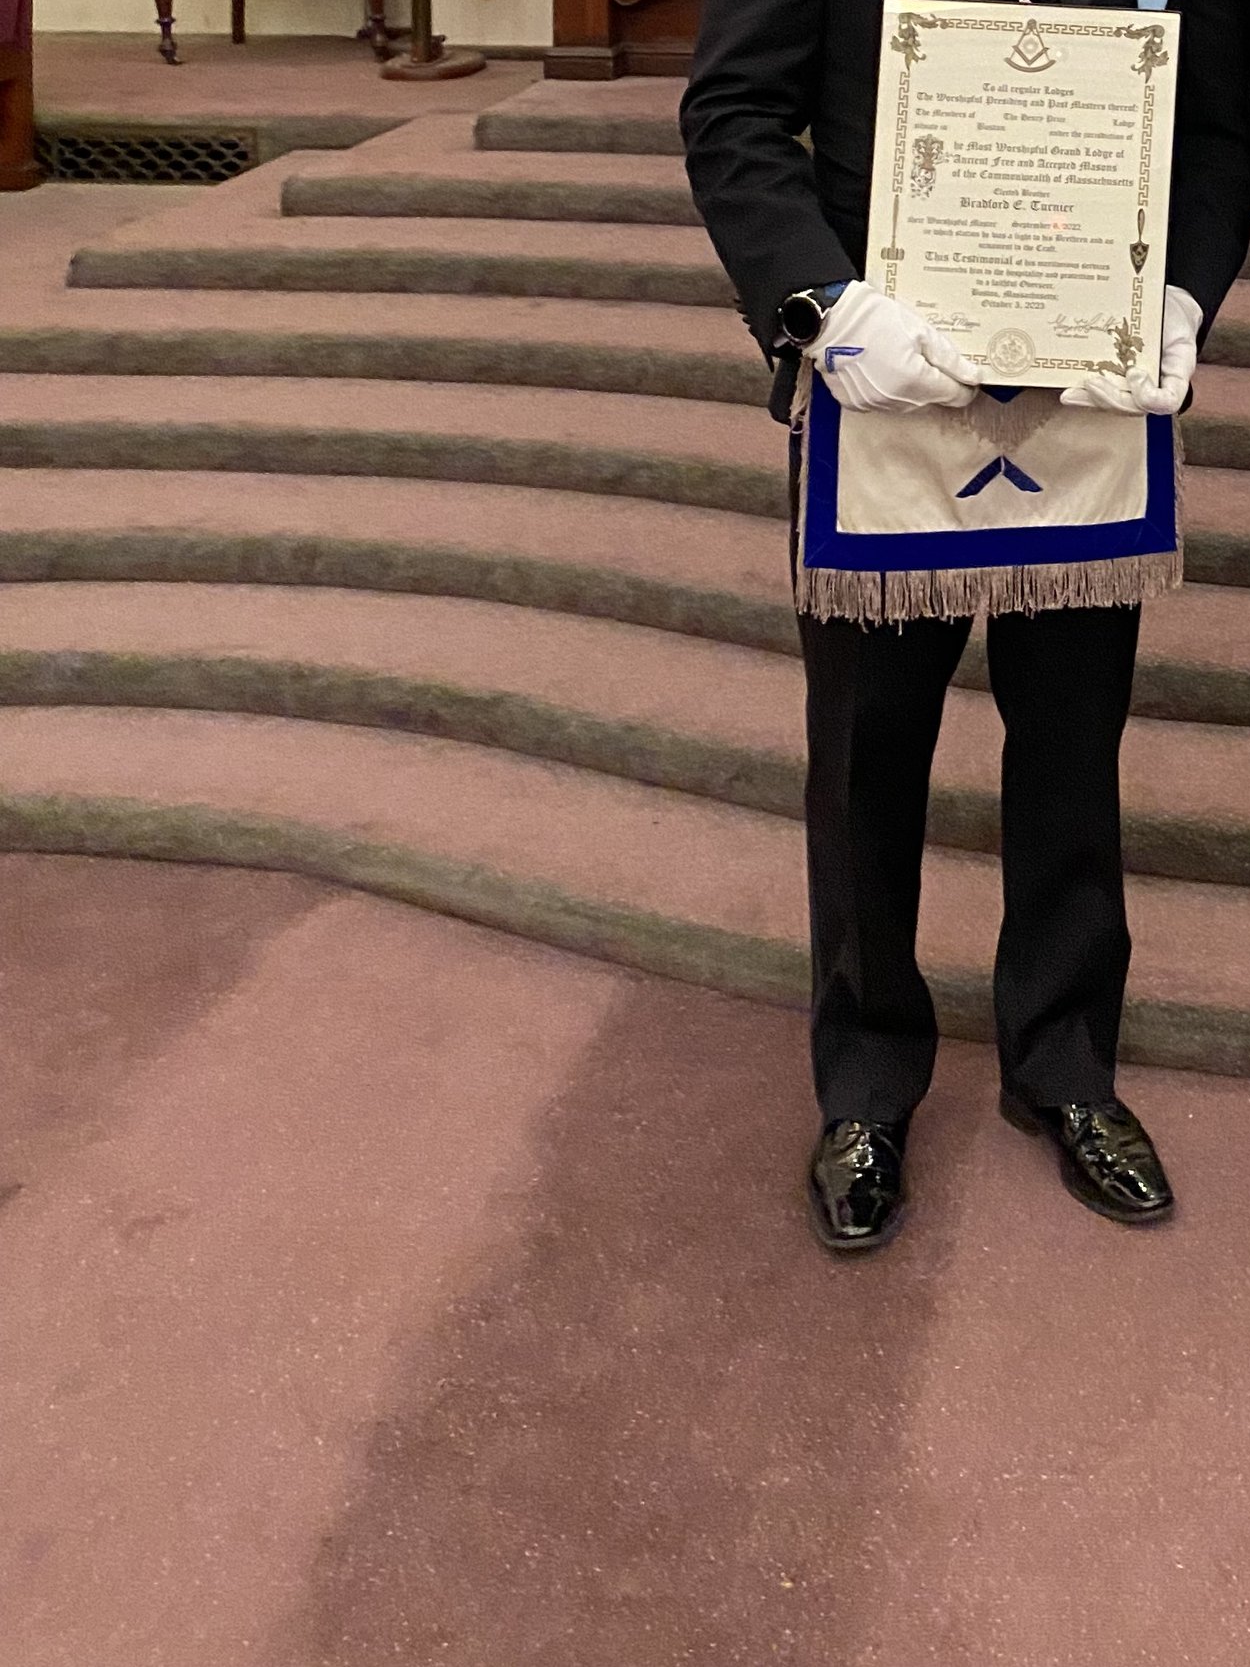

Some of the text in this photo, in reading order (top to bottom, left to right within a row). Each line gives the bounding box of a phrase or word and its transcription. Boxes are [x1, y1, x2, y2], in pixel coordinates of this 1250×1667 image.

[982, 82, 1075, 97] To all regular Lodges
[916, 91, 933, 101] The
[936, 92, 983, 104] Worshipful
[985, 95, 1028, 107] Presiding
[1030, 99, 1045, 107] and
[1048, 99, 1069, 109] Past
[1070, 100, 1106, 110] Masters
[915, 108, 930, 116] The
[932, 109, 967, 118] Members
[968, 111, 976, 119] of
[1003, 112, 1018, 121] The
[1112, 119, 1136, 128] Lodge
[1071, 130, 1082, 138] the
[1126, 133, 1134, 141] of
[966, 141, 993, 152] Most
[995, 141, 1048, 155] Worshipful
[1050, 145, 1081, 156] Grand
[1084, 146, 1114, 159] Lodge
[1115, 149, 1125, 159] of
[953, 153, 1118, 172] Ancient Free and Accepted Masons
[951, 168, 1134, 187] of the Commonwealth of Massachusetts
[959, 196, 1075, 213] Bradford E. Turnier
[926, 216, 968, 226] Worshipful
[1011, 220, 1052, 230] September
[1042, 234, 1053, 242] his
[1055, 234, 1088, 244] Brethren
[1089, 237, 1104, 245] and
[924, 250, 949, 262] This
[952, 252, 1013, 266] Testimonial
[1015, 258, 1023, 266] of
[1024, 258, 1036, 267] his
[968, 266, 984, 274] him
[993, 268, 1005, 276] the
[980, 299, 1014, 309] October
[1024, 301, 1046, 310] 2023
